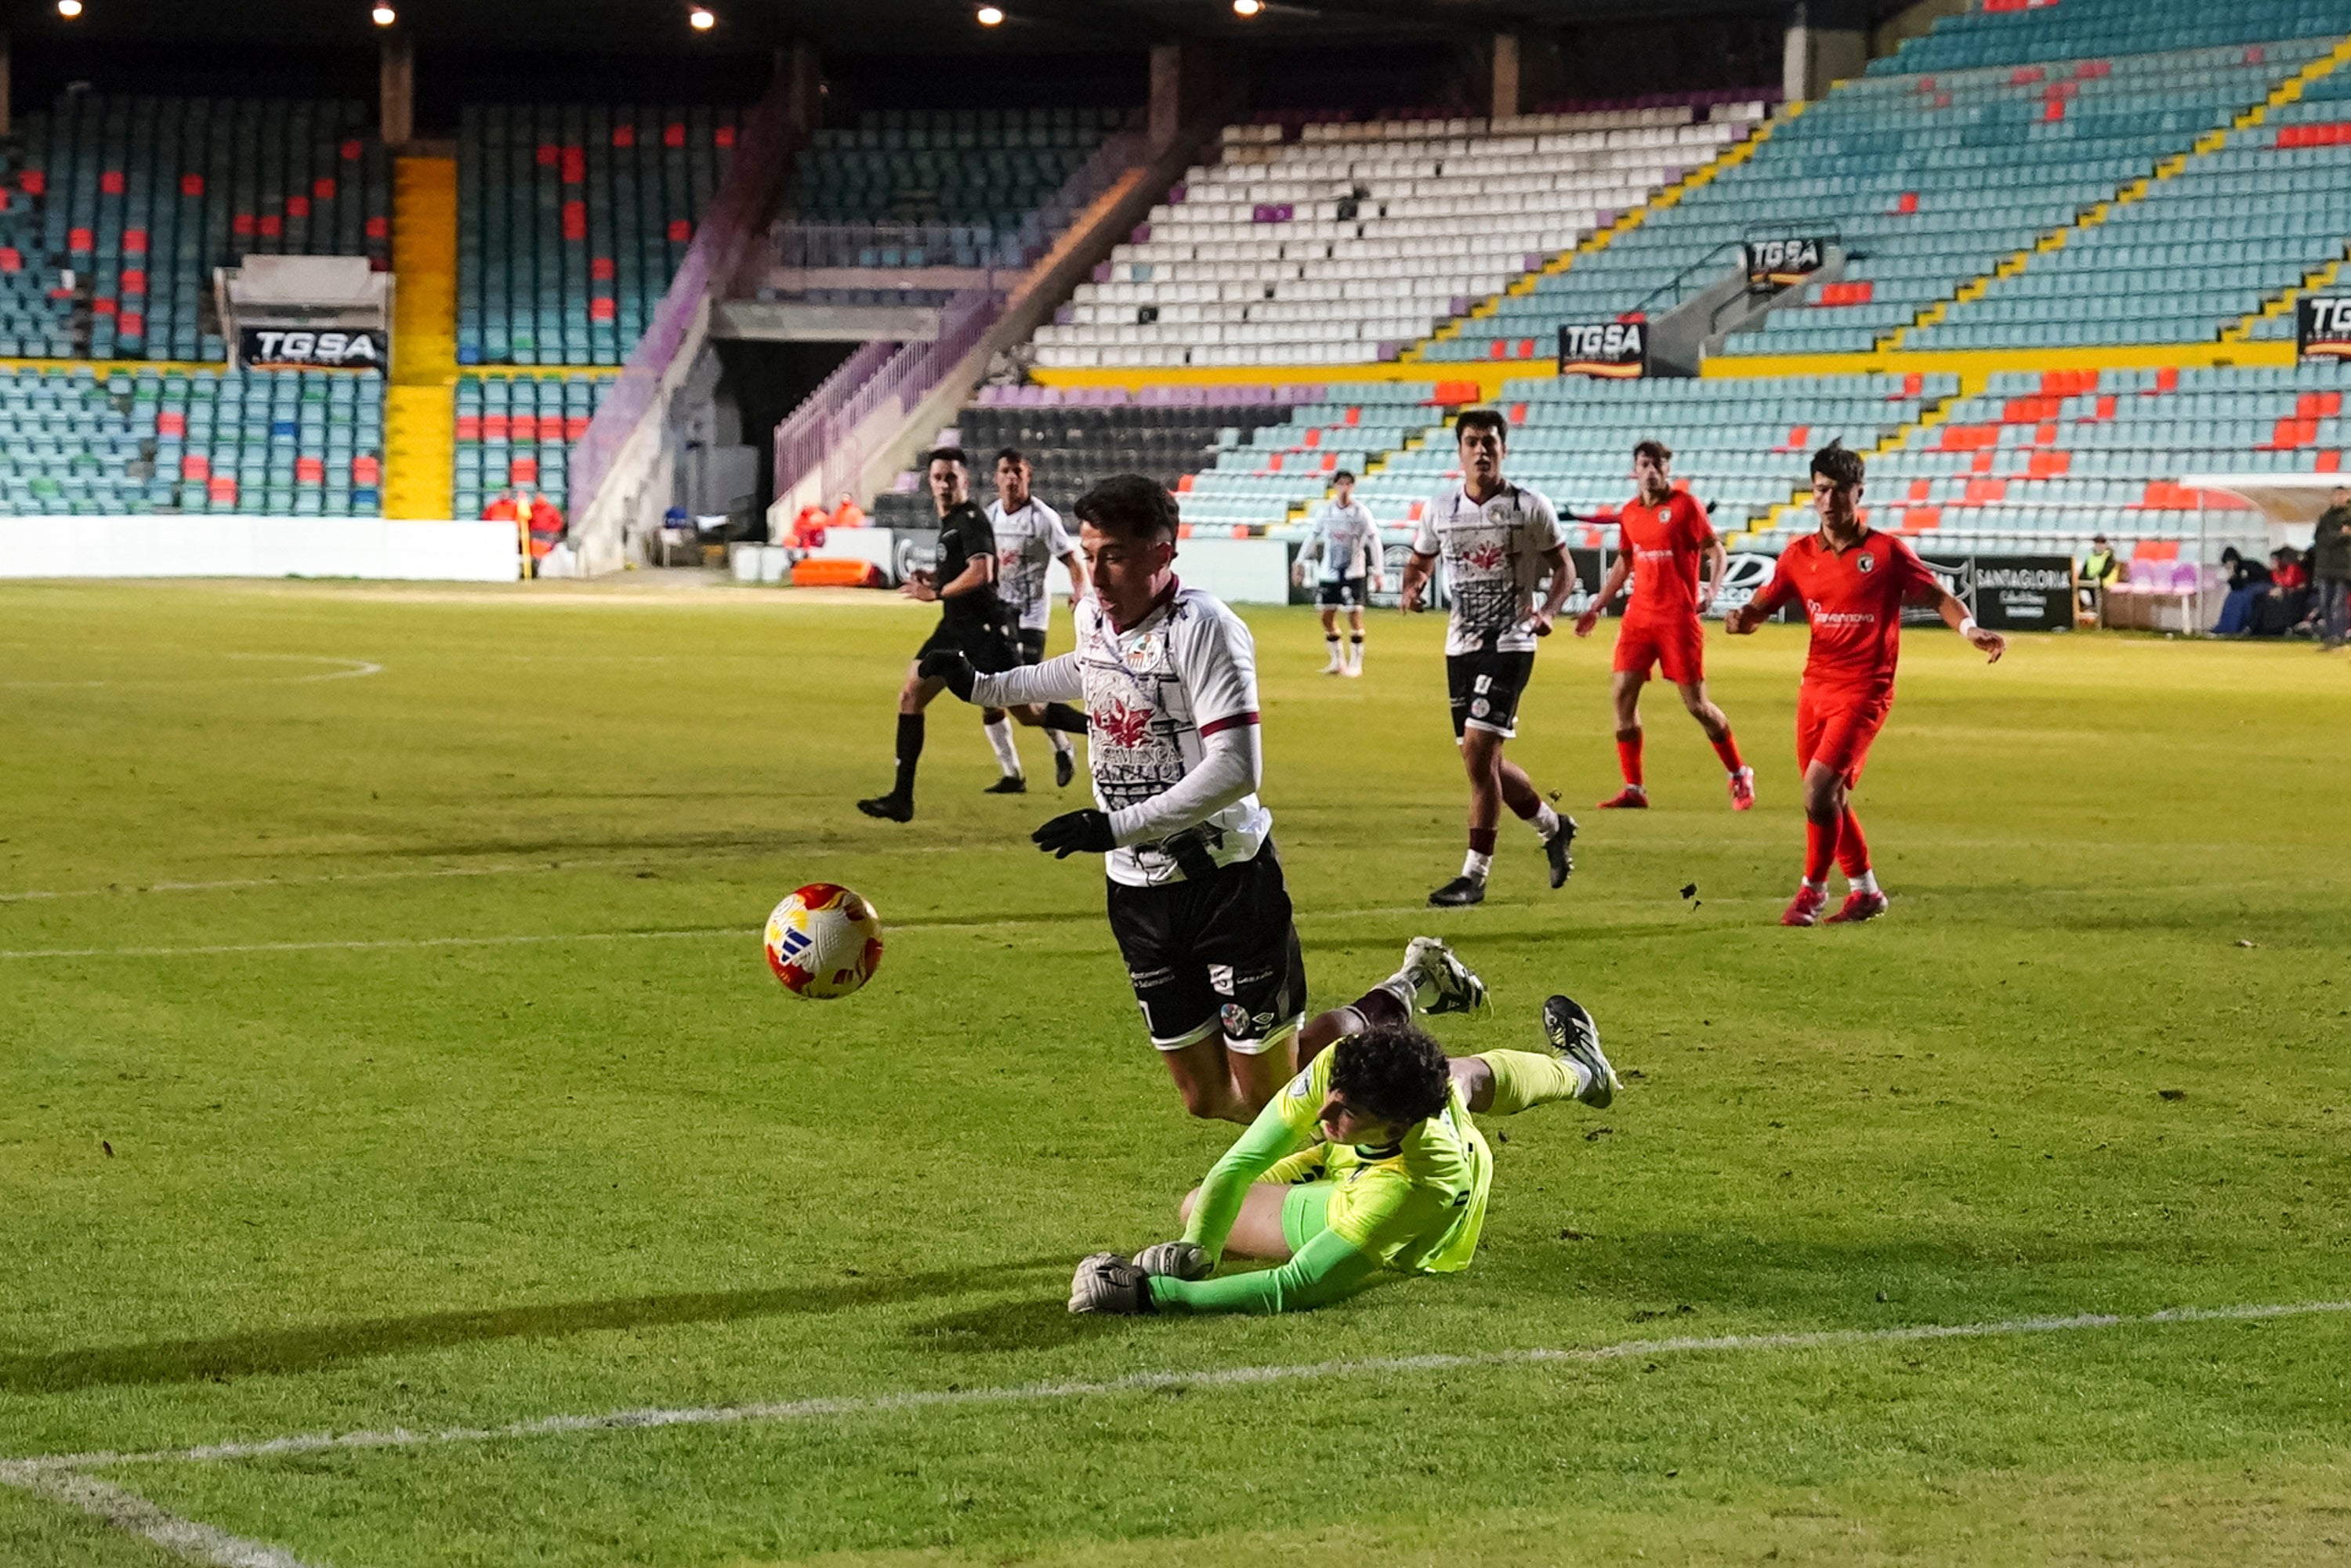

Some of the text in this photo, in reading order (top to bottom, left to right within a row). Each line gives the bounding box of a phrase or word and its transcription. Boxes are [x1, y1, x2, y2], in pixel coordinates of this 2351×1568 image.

[1751, 239, 1817, 270] TGSA
[255, 331, 376, 360] TGSA
[1567, 324, 1642, 356] TGSA
[1976, 568, 2071, 590] SANTAGLORIA
